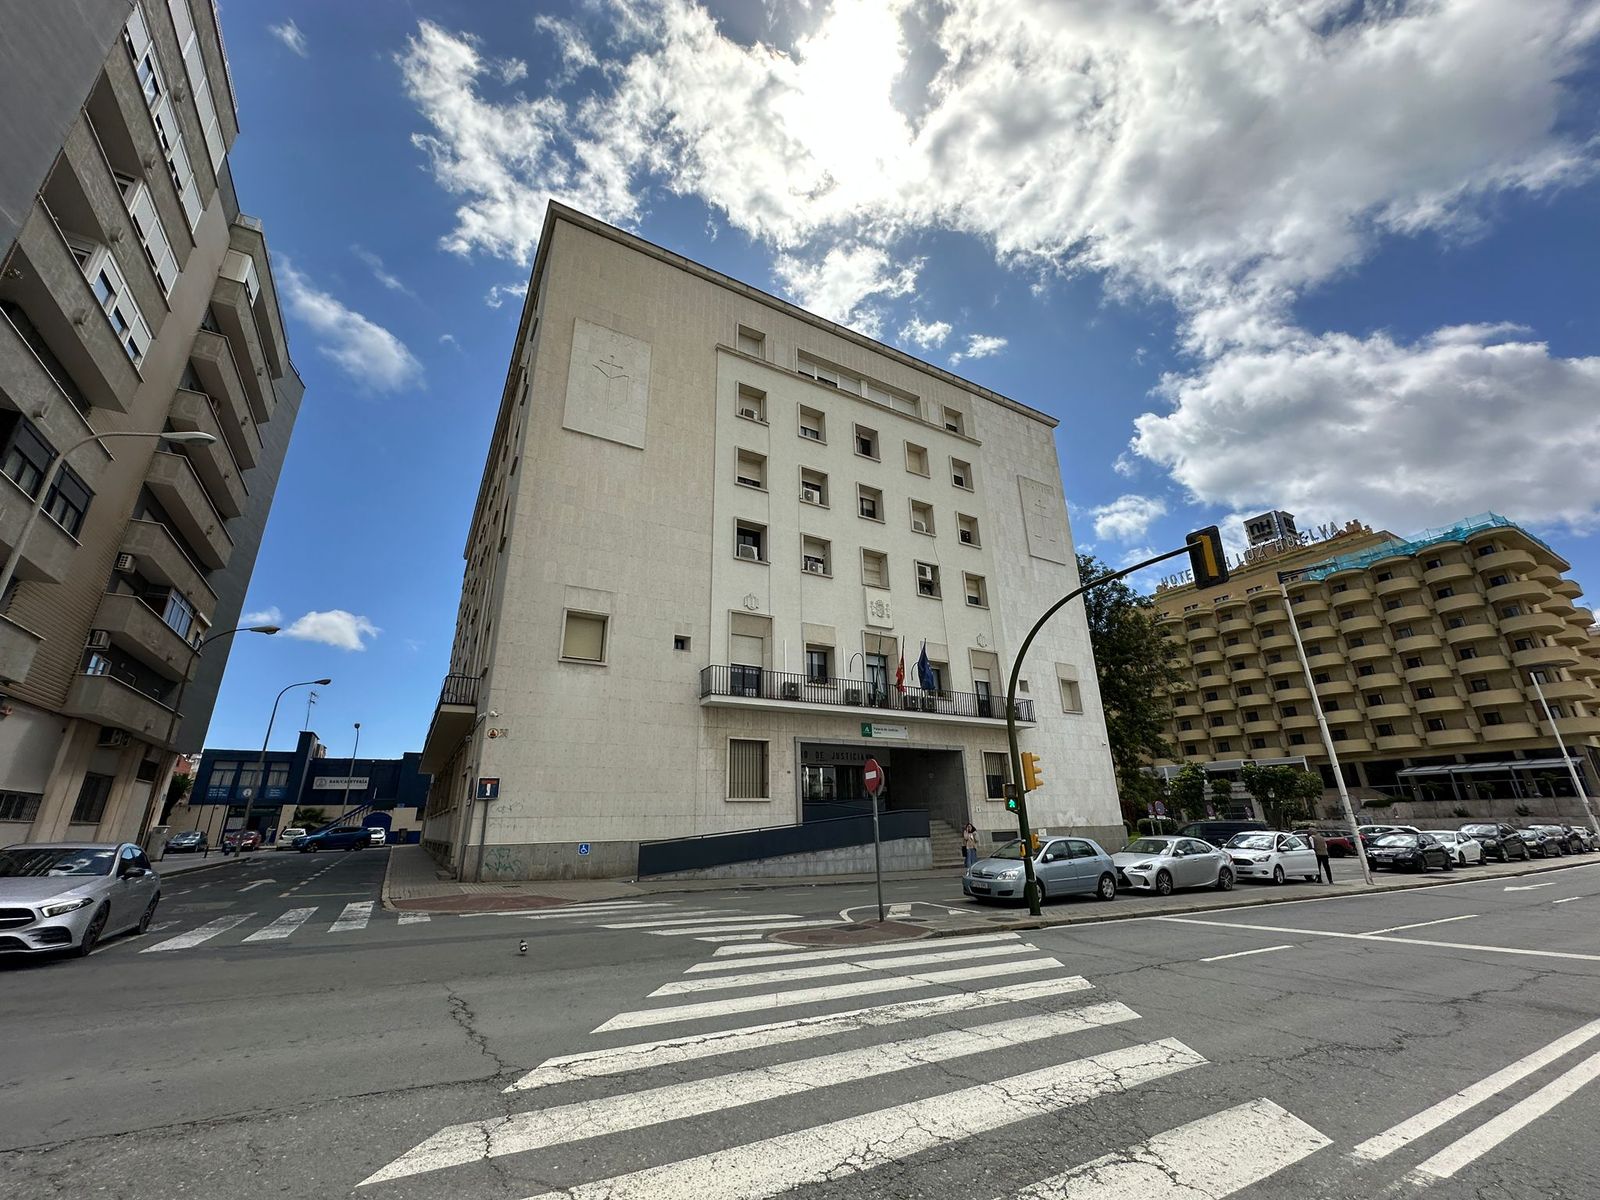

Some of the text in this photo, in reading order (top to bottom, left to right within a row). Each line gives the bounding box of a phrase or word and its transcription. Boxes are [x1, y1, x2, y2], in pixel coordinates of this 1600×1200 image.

[1161, 568, 1194, 588] HOTE
[1274, 521, 1339, 552] HUELVA
[816, 751, 825, 759] DE
[832, 751, 865, 760] JUSTICIA
